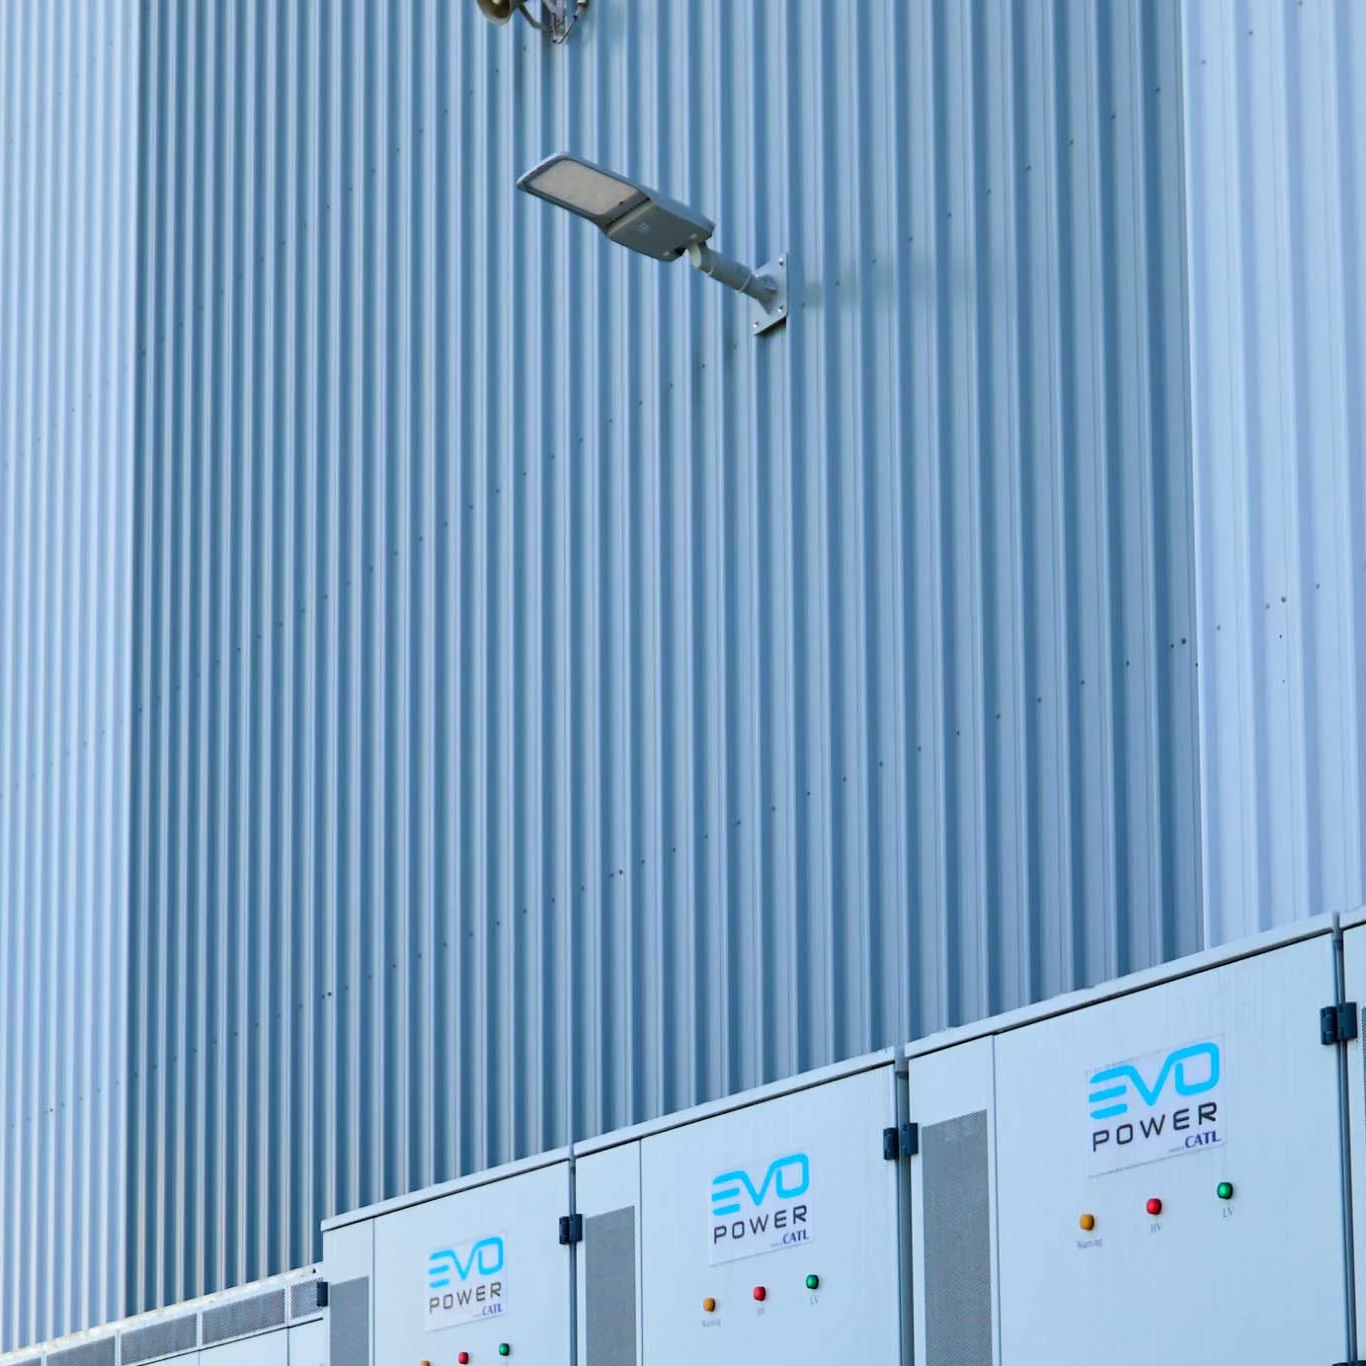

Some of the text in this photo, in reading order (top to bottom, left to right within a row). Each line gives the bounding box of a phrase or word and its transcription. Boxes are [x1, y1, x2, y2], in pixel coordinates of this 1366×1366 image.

[1088, 1041, 1220, 1120] EVO
[1092, 1101, 1218, 1152] POWER
[1185, 1130, 1221, 1148] CATL
[711, 1153, 810, 1216] EVO
[713, 1205, 808, 1245] POWER
[782, 1228, 810, 1244] CATL
[428, 1236, 504, 1289] EVO
[429, 1281, 502, 1315] POWER
